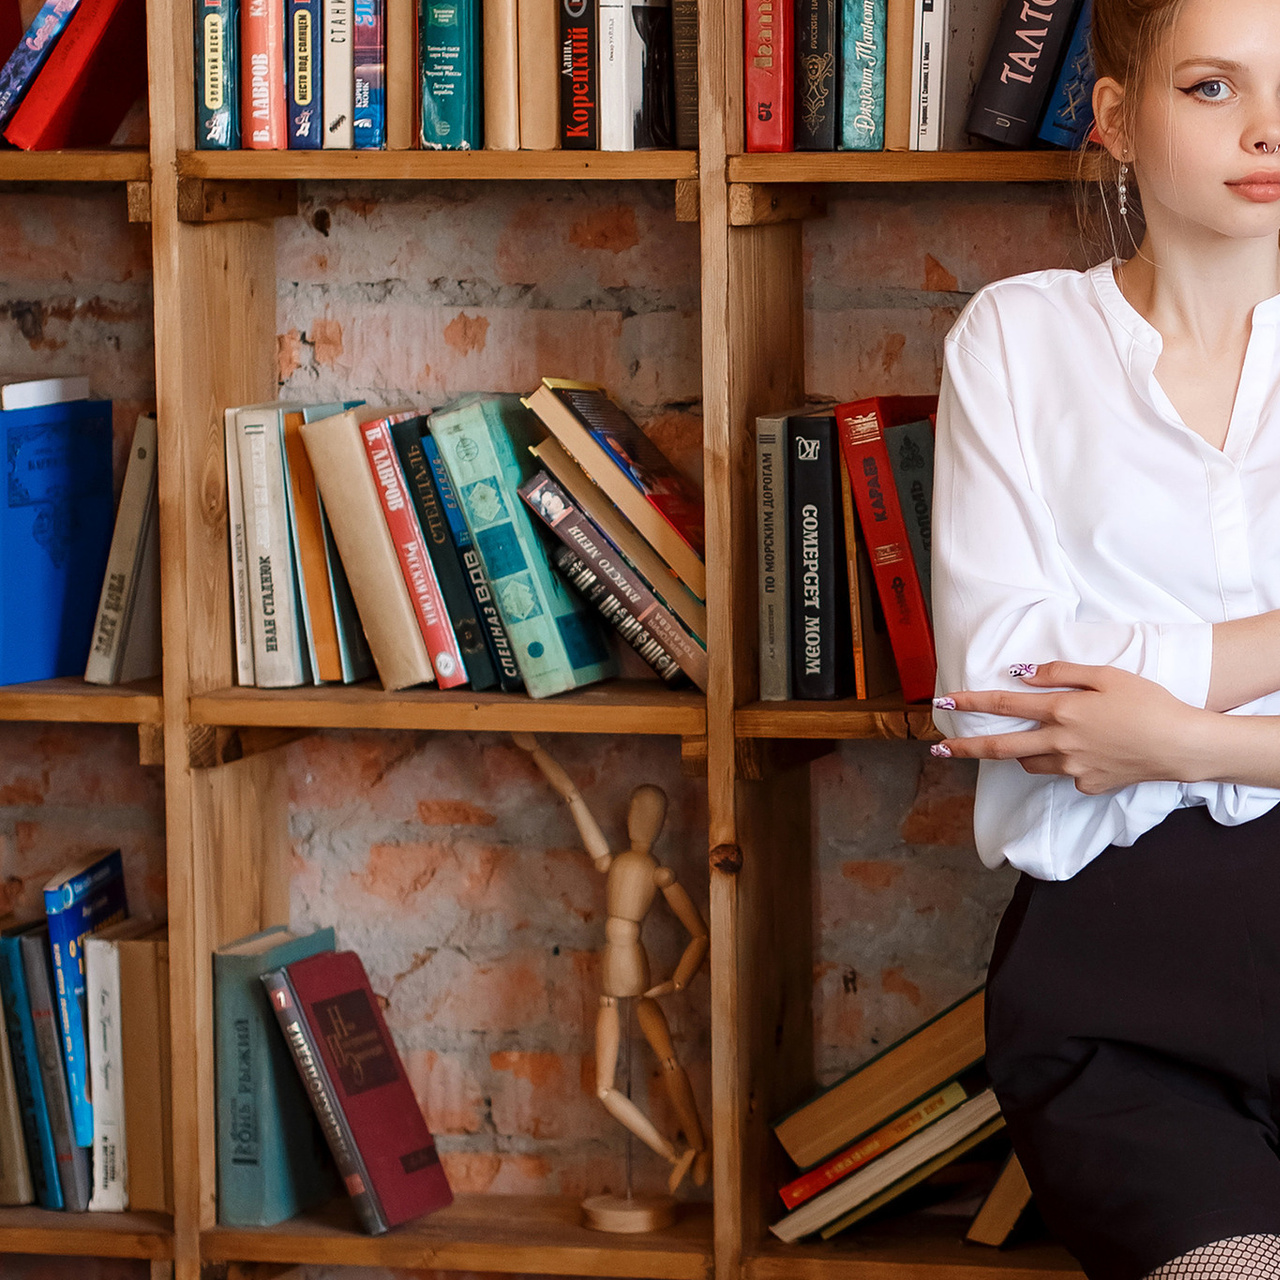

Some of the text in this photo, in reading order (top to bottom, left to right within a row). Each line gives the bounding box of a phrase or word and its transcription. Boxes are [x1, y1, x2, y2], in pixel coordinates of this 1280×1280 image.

[298, 14, 308, 52] СОЛНЦЕМ
[298, 56, 308, 71] ПОД
[810, 13, 819, 49] РУССКИЕ
[854, 0, 876, 136] Джудит Макнот
[298, 74, 308, 101] МЕСТО
[567, 27, 594, 137] Корецкий
[407, 445, 447, 544] СТЕНДАЛЬ
[762, 453, 776, 593] ПО МОРСКИМ ДОРОГАМ
[862, 456, 888, 522] КАРАЕВ
[259, 556, 278, 652] ИВАН СТАДНЮК
[567, 525, 642, 603] ВМЕСТО МЕНЯ
[802, 504, 820, 674] СОМЕРСЕТ МОЭМ
[463, 549, 518, 678] СПЕЦНАЗ ВДВ
